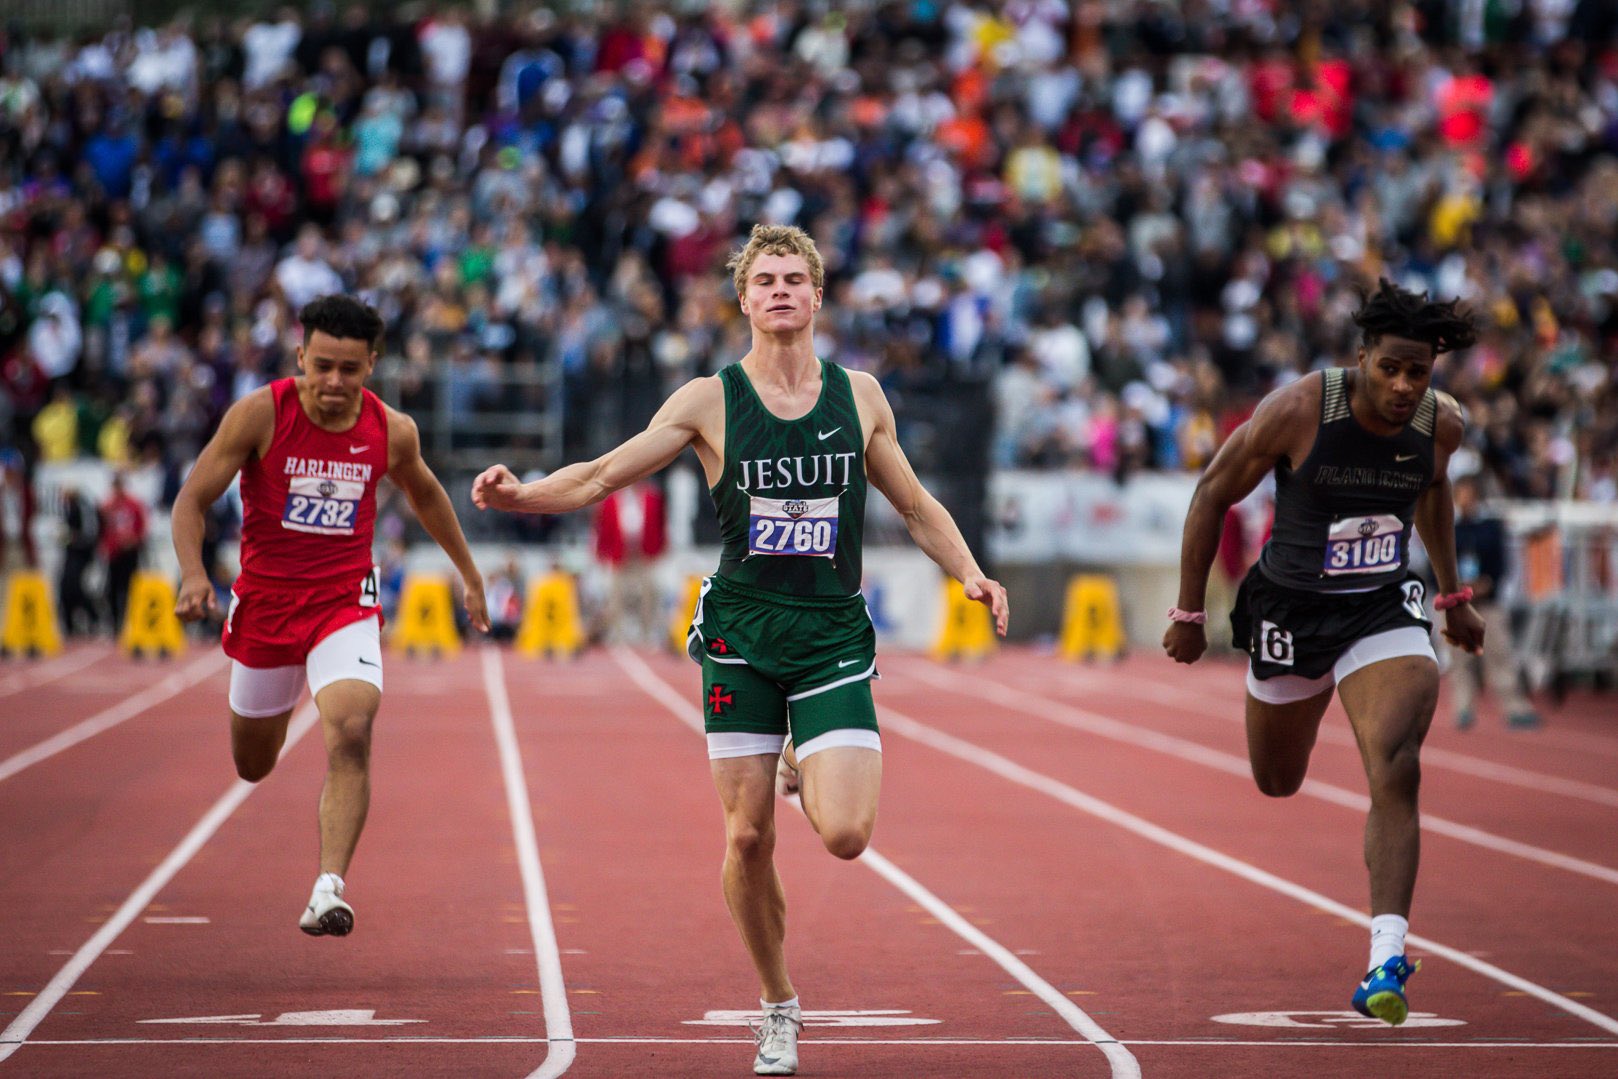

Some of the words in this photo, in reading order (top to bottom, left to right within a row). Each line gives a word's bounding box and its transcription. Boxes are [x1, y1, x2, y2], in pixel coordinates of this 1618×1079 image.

[284, 456, 373, 482] HARLINGEN
[736, 452, 856, 490] JESUIT
[1314, 465, 1376, 486] PLANO
[288, 496, 355, 528] 2732
[782, 504, 809, 513] STATE
[755, 519, 832, 552] 2760
[1331, 533, 1396, 568] 3100
[364, 568, 378, 603] 4
[1266, 627, 1290, 660] 6
